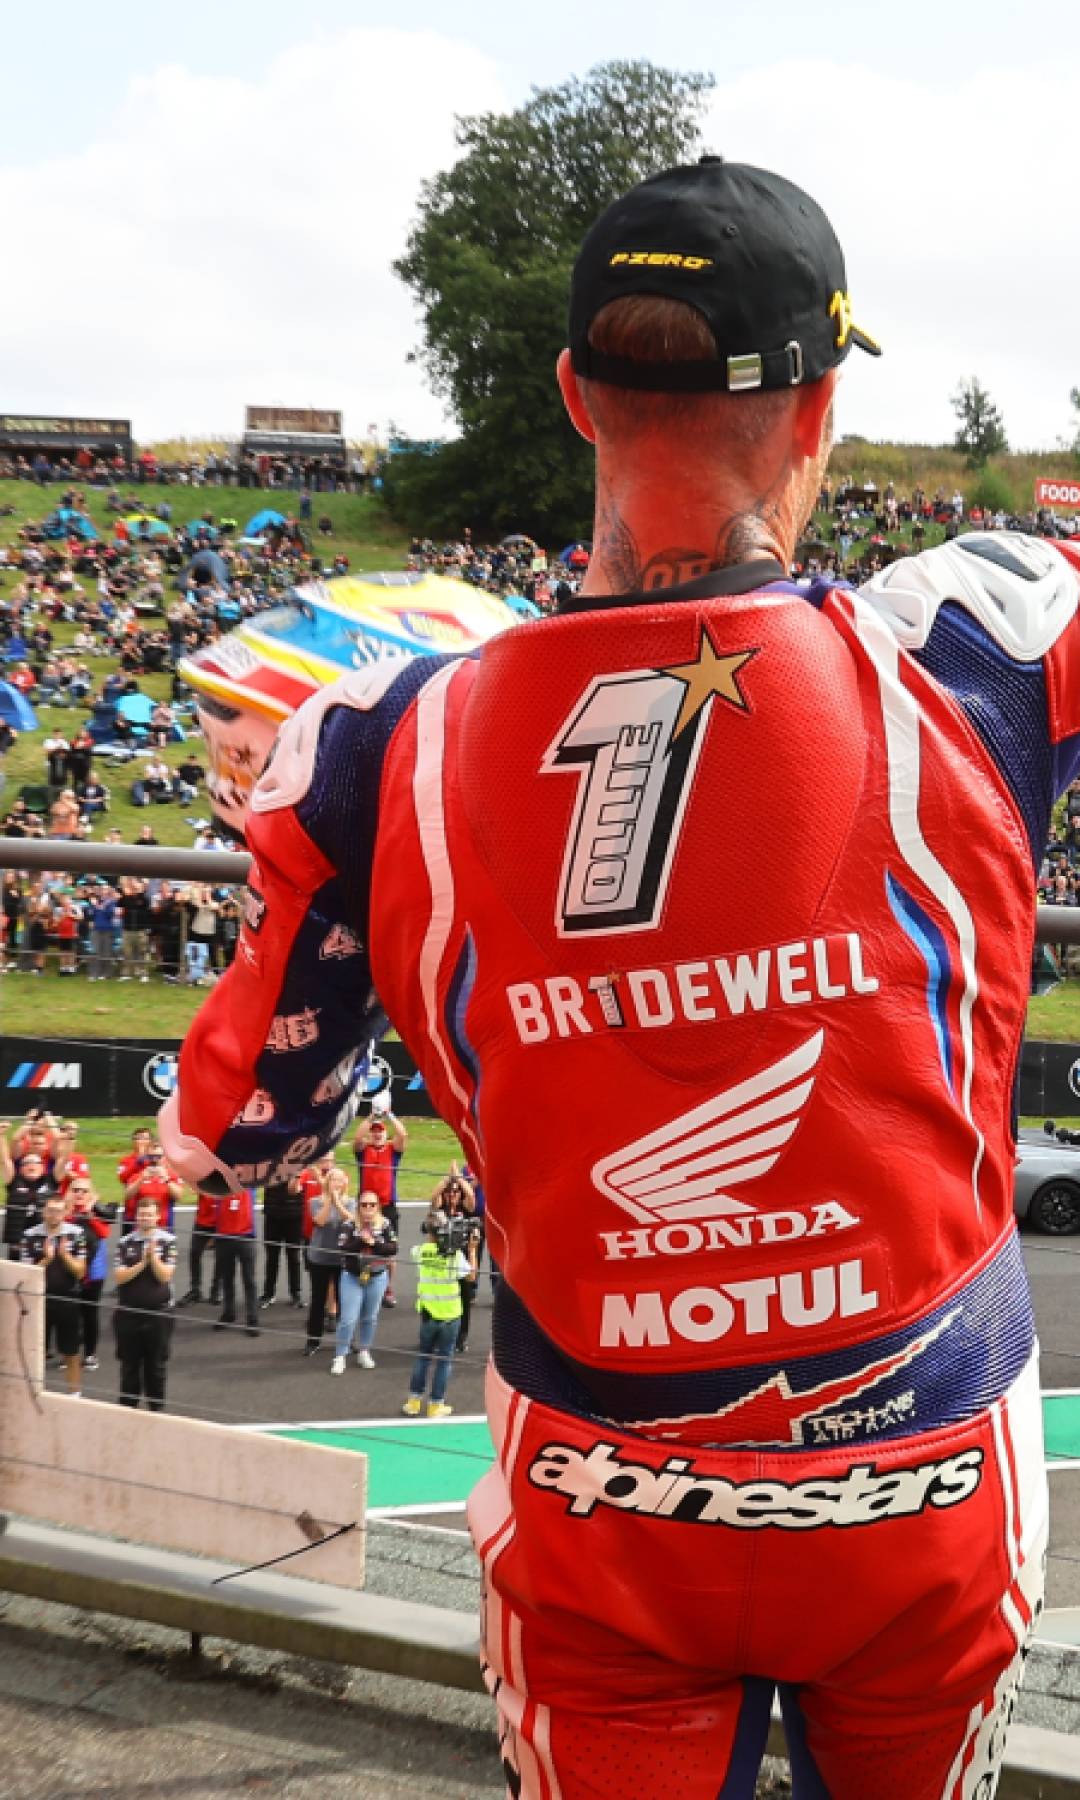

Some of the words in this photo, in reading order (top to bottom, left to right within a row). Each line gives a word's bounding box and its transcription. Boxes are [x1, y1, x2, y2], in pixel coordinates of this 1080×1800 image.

[1040, 484, 1080, 502] FOOD
[539, 669, 715, 938] 1
[582, 721, 663, 905] OLLIE
[598, 1200, 860, 1260] HONDA
[600, 1260, 878, 1347] MOTUL
[529, 1443, 984, 1529] alpinestars
